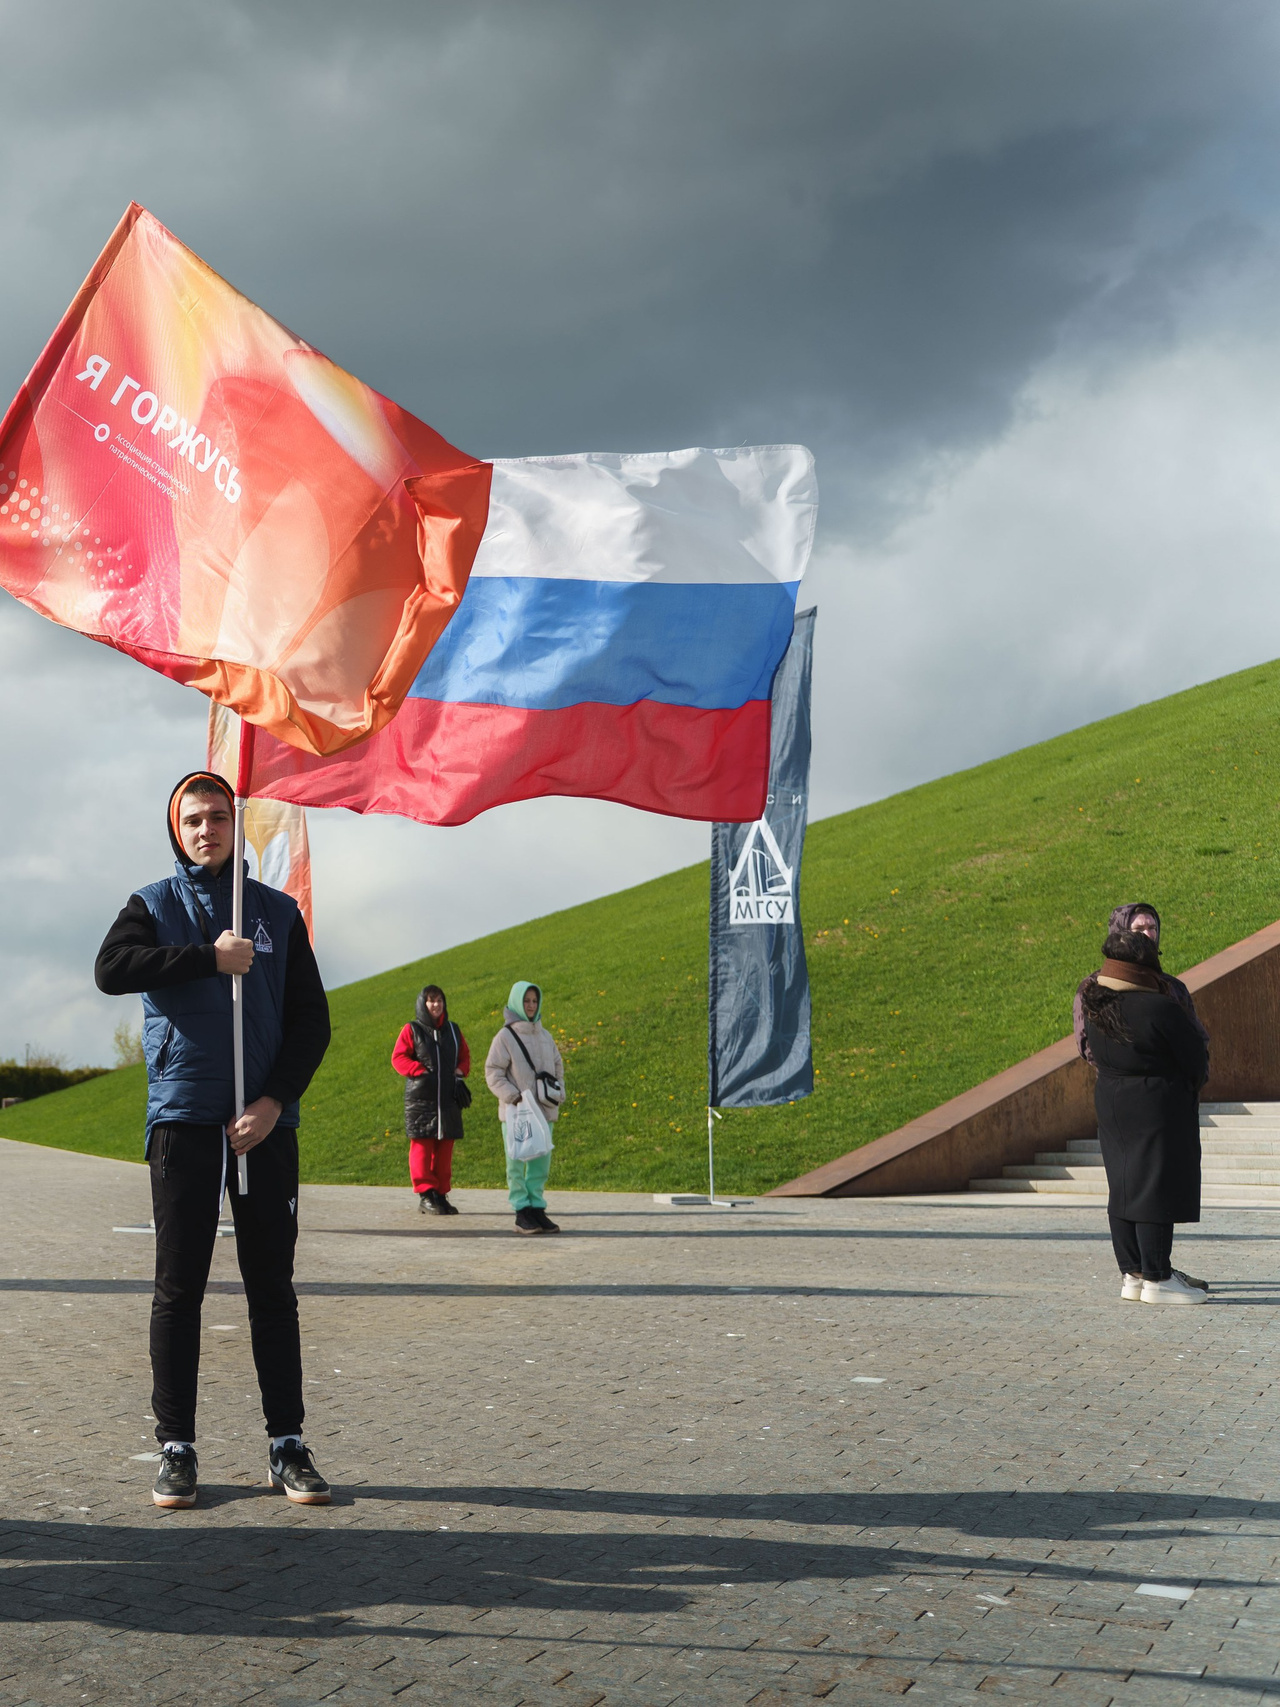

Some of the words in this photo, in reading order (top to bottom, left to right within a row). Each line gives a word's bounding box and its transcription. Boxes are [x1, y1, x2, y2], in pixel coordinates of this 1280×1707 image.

[75, 354, 111, 391] Я
[110, 375, 242, 504] ГОРЖУСЬ
[108, 444, 158, 484] патриотических
[157, 480, 179, 501] клубов
[114, 433, 153, 465] Ассоциация
[151, 461, 191, 495] студенческих
[734, 900, 789, 919] МГСУ
